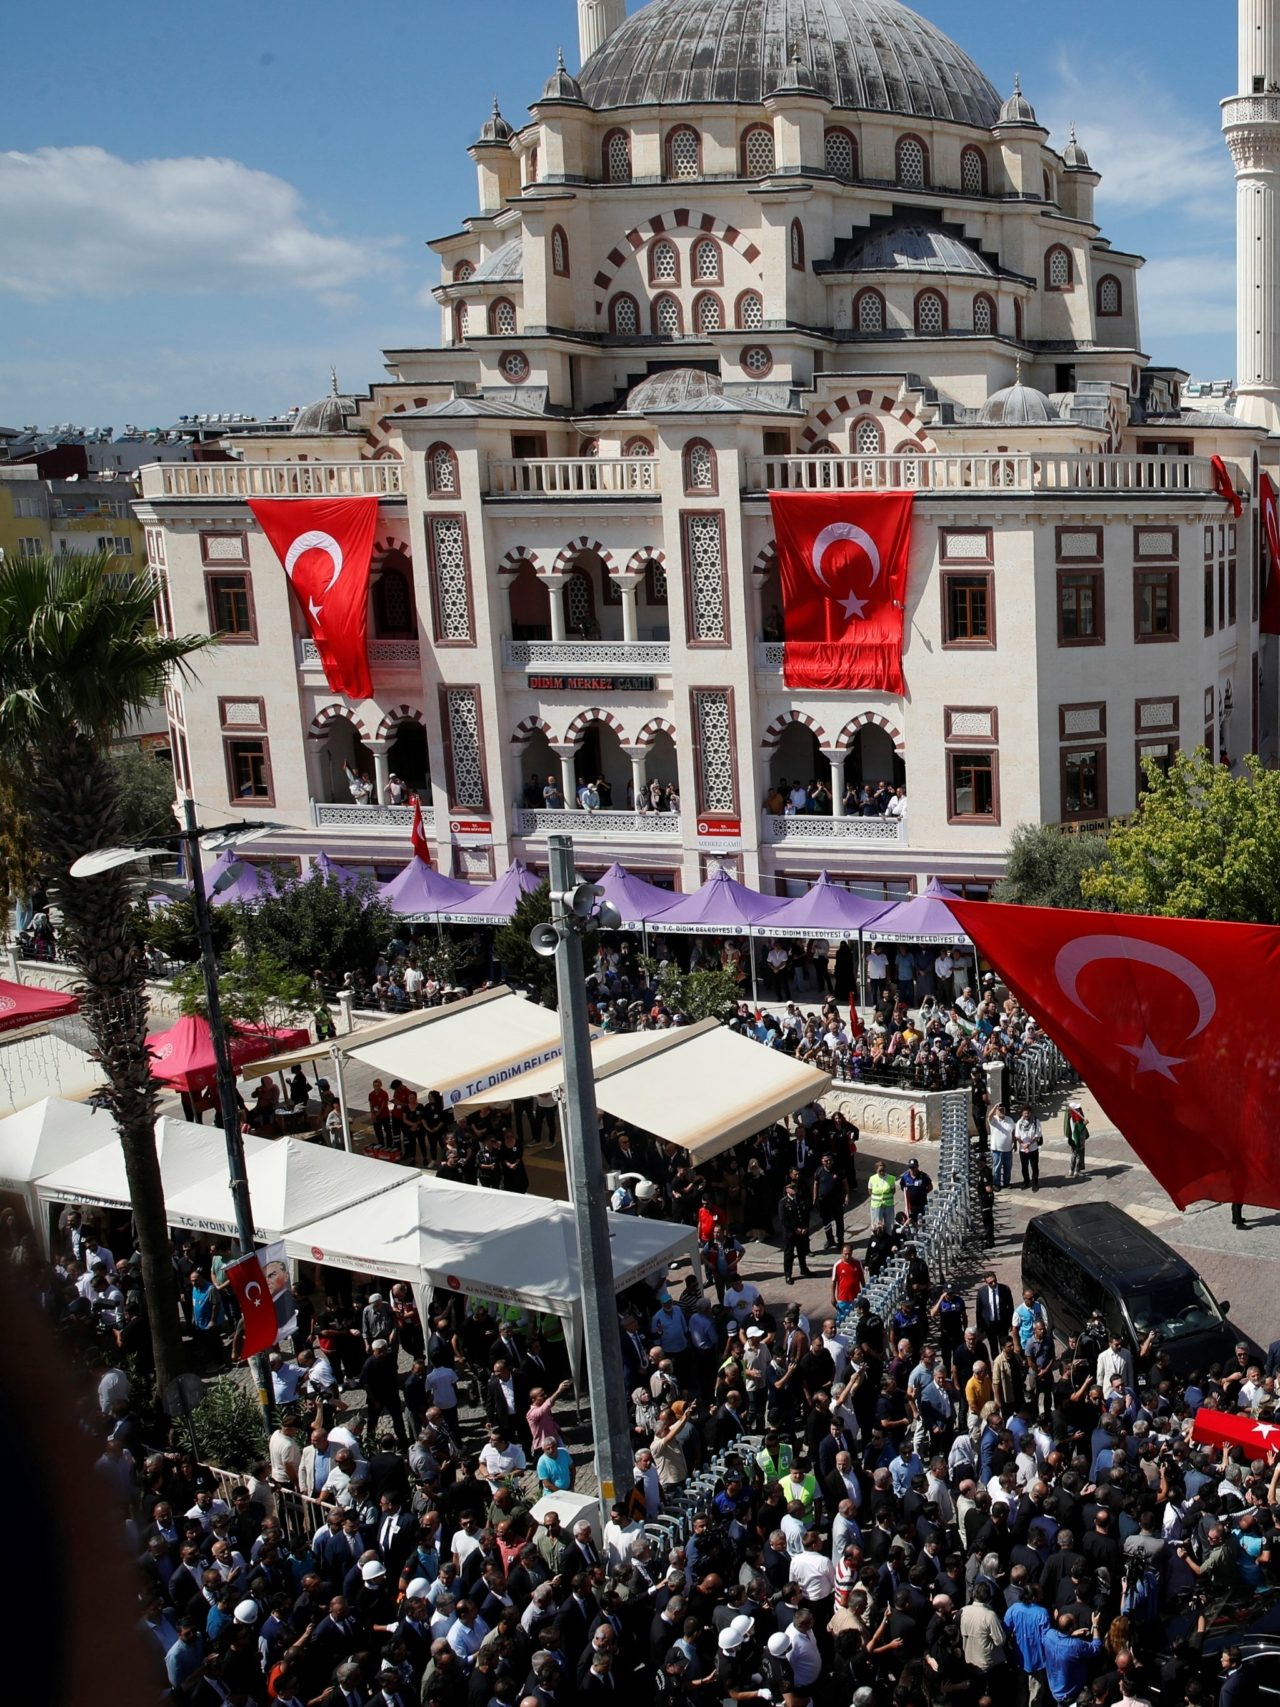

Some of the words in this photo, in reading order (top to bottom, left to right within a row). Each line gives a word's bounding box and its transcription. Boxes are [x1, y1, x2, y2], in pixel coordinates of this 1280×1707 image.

[530, 675, 563, 689] DİDİM
[567, 677, 612, 690] MERKEZ
[1060, 826, 1077, 834] T.C.
[1080, 820, 1105, 833] DİDİM
[695, 926, 733, 934] BELEDİYESİ
[802, 930, 841, 938] BELEDİYESİ
[895, 932, 914, 941] DİDİM
[915, 934, 955, 943] BELEDİYESİ
[466, 1080, 487, 1097] T.C.
[488, 1064, 522, 1088] DİDİM
[179, 1217, 197, 1228] T.C.
[199, 1220, 226, 1232] AYDIN
